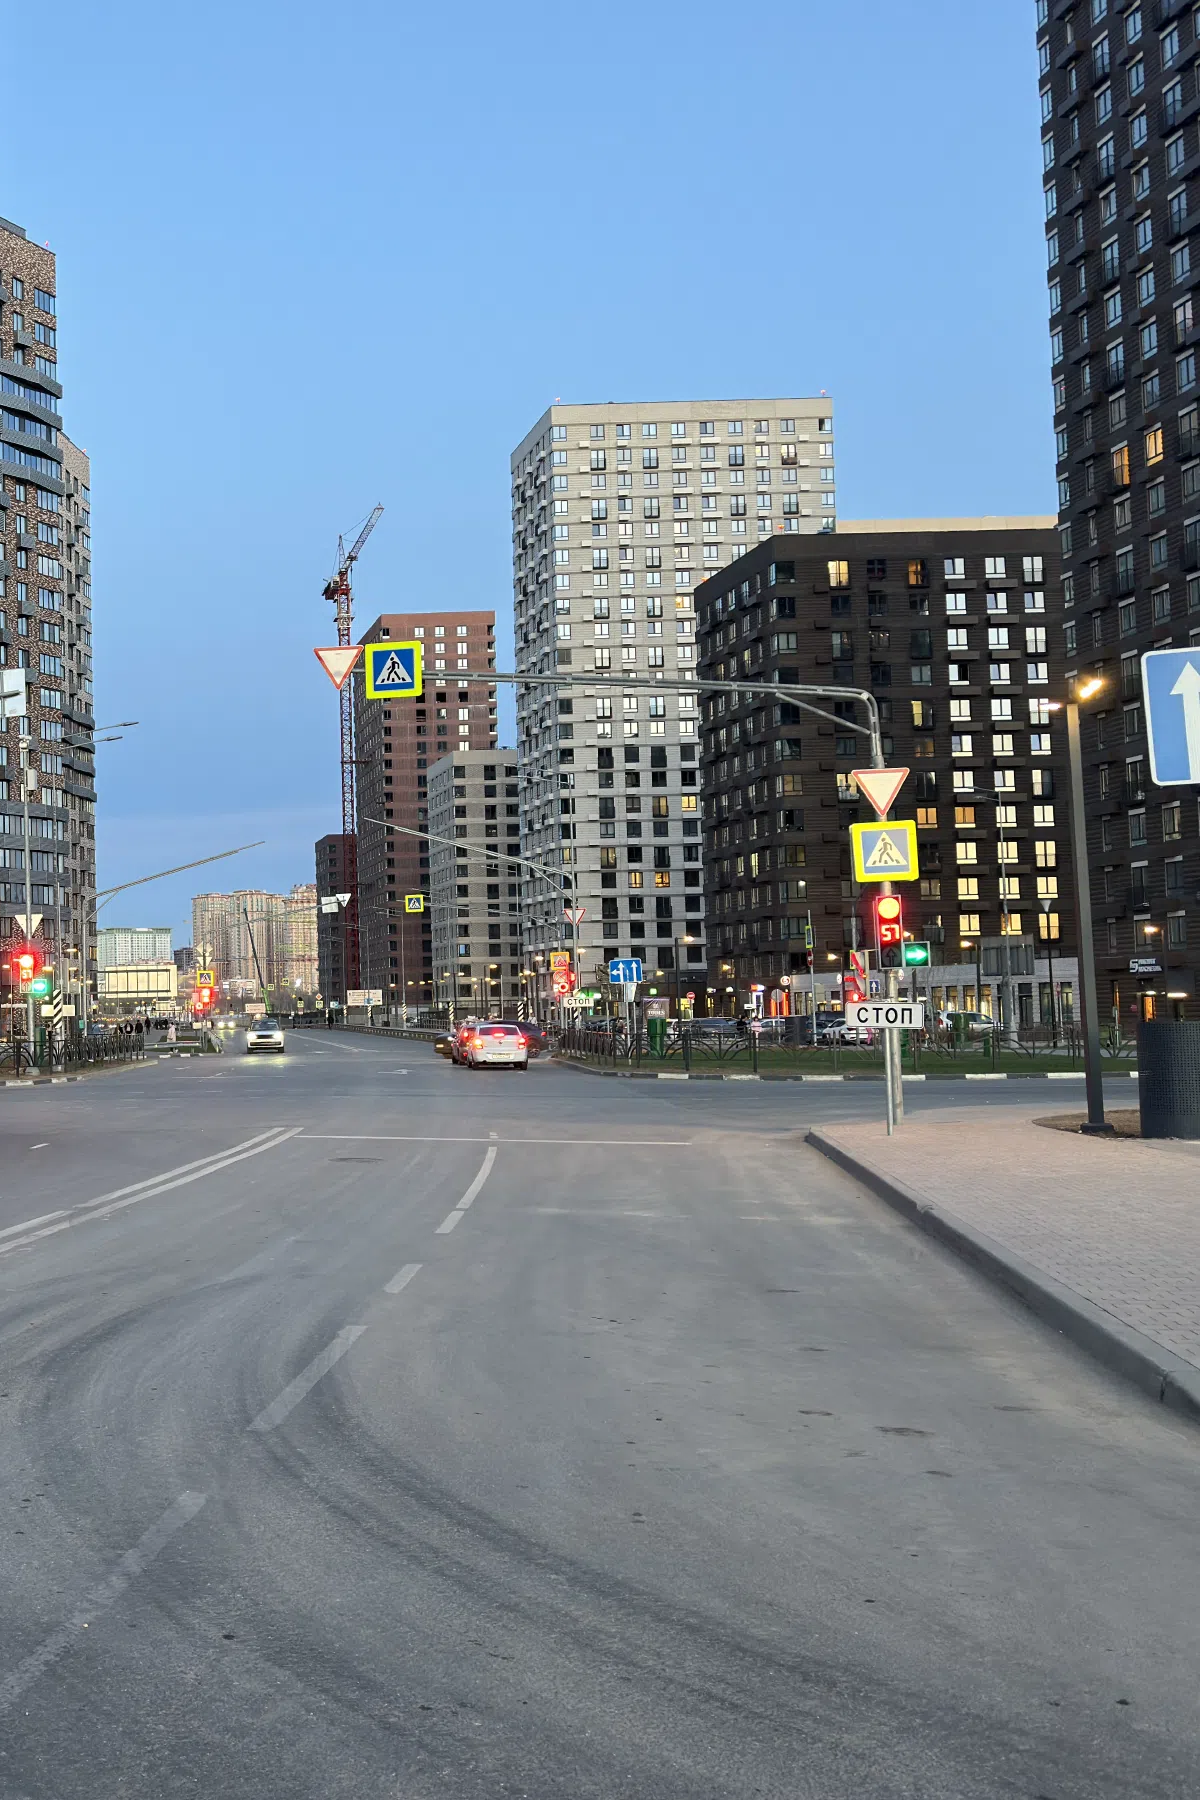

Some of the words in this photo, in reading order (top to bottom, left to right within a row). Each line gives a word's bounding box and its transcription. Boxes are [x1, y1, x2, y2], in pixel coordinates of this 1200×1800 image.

[881, 924, 900, 941] 57
[22, 970, 32, 979] 57
[857, 1007, 913, 1024] СТОП
